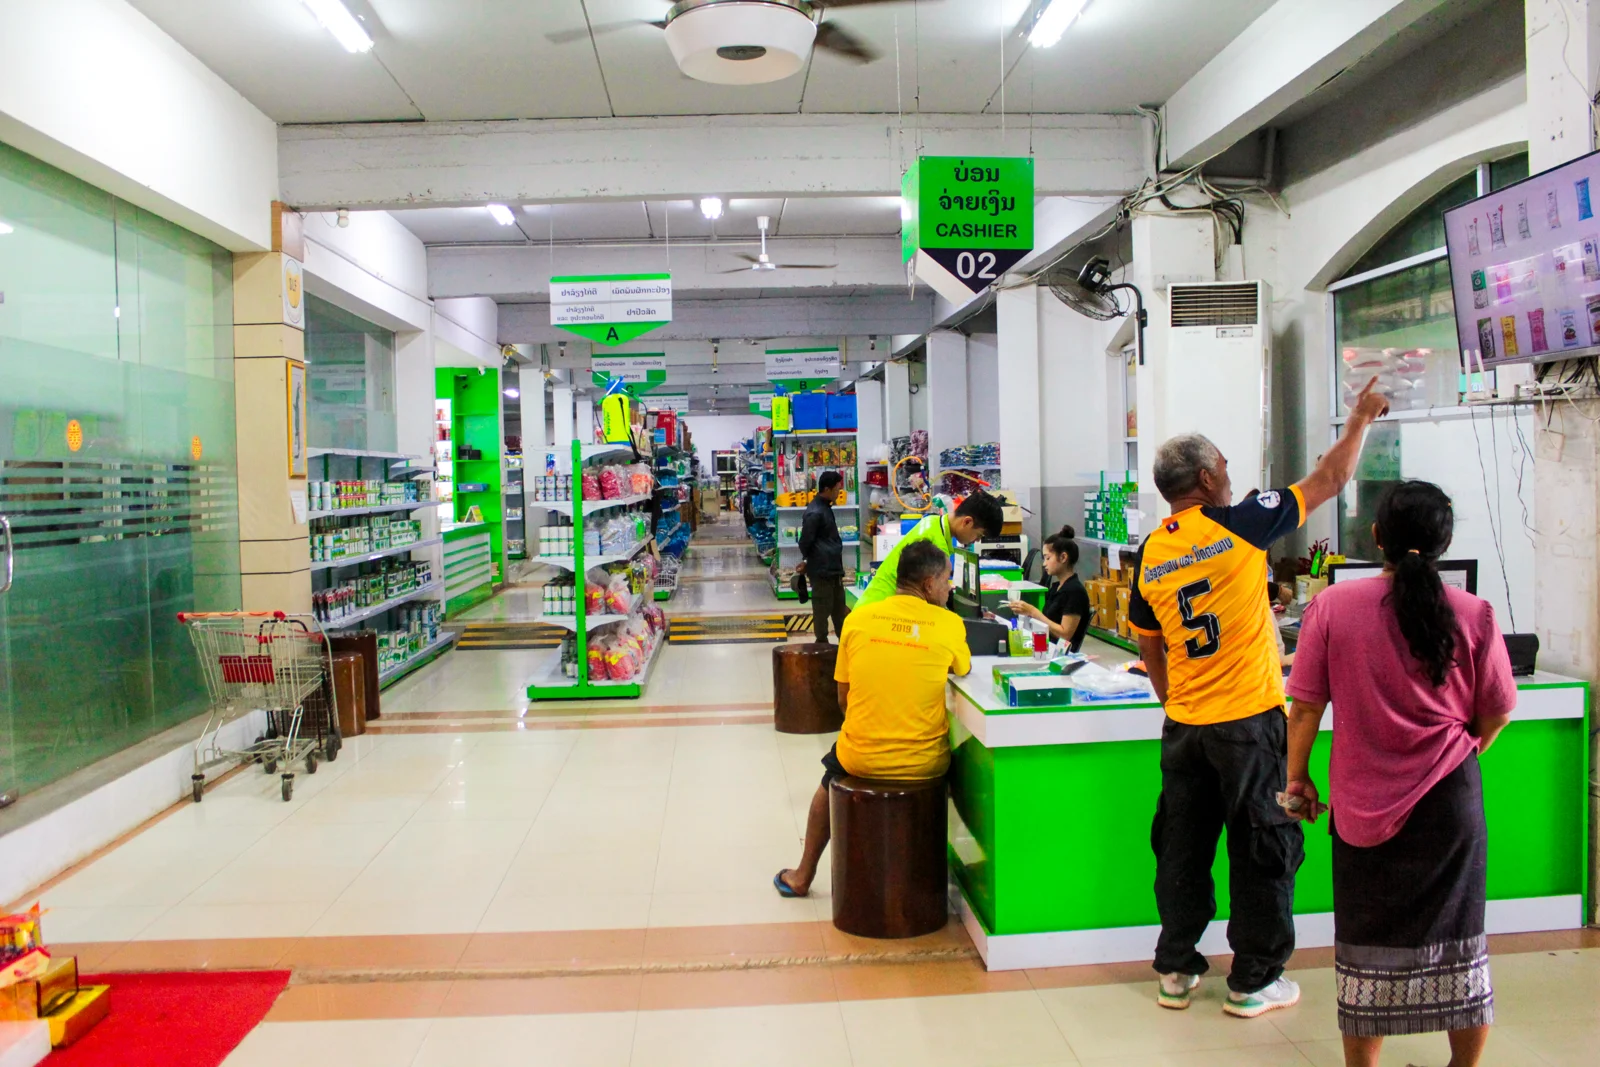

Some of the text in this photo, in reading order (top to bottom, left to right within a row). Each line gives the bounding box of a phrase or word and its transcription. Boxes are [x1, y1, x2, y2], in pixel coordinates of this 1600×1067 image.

[953, 160, 1000, 183] ບ່ອນ
[938, 188, 1015, 216] ຈ່າຍເງິນ
[935, 223, 1017, 239] CASHIER
[956, 252, 997, 279] 02
[605, 327, 620, 341] A
[625, 384, 634, 394] C
[799, 380, 807, 390] B
[1176, 577, 1221, 659] 5
[891, 623, 912, 634] 2019
